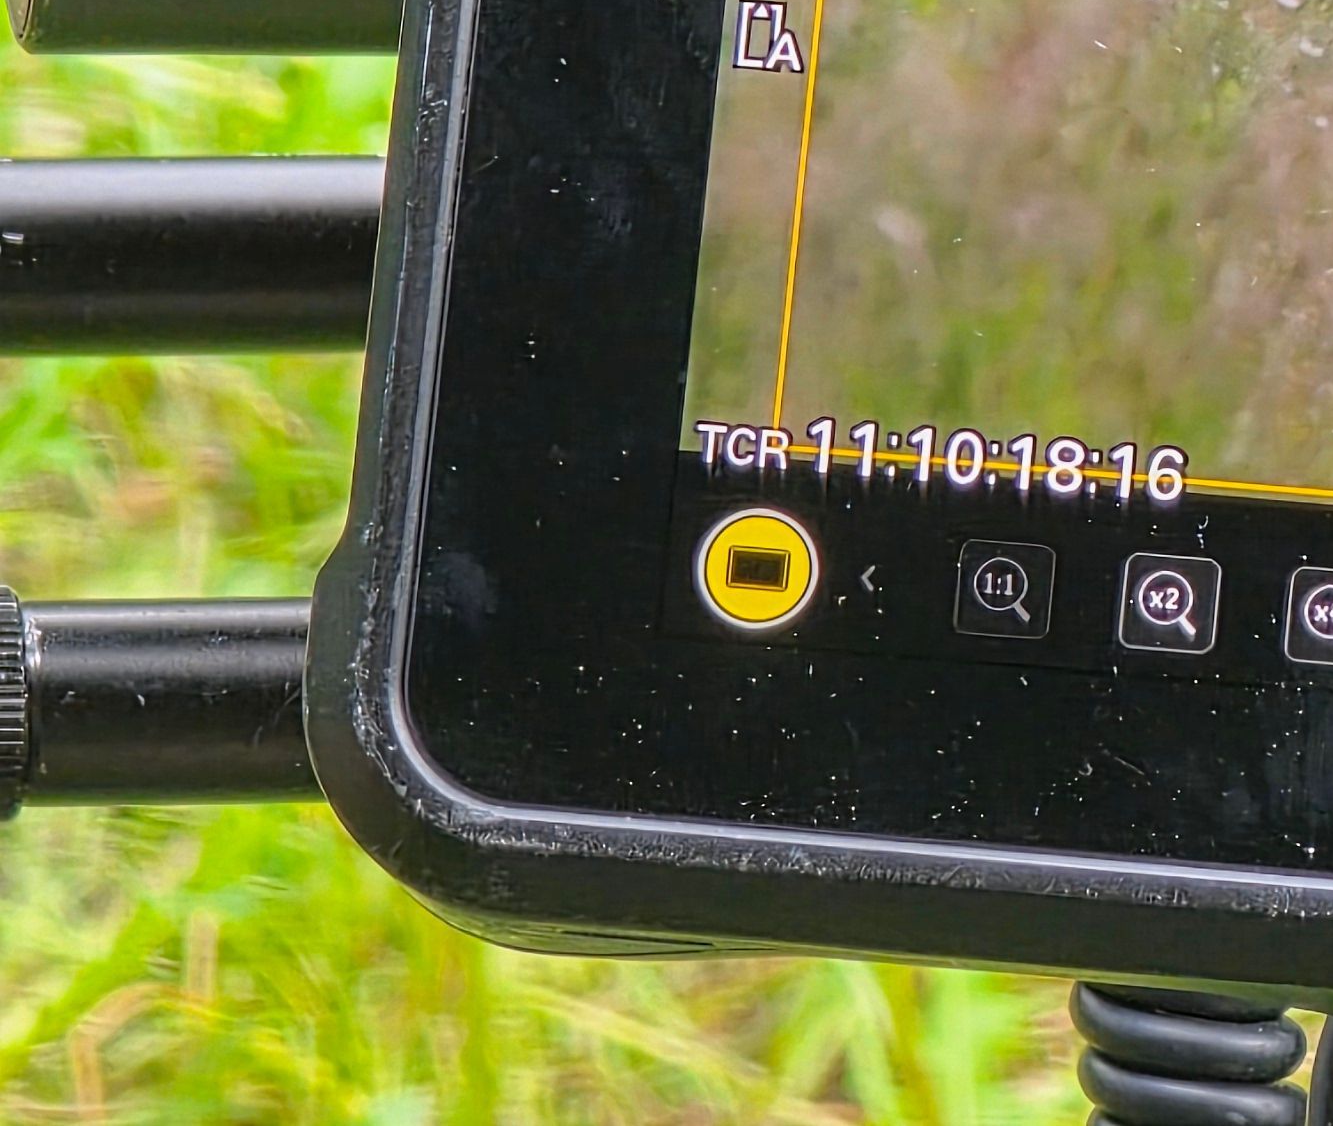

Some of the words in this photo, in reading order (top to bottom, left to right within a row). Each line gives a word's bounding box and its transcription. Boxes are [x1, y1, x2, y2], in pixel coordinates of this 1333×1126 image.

[696, 422, 790, 470] TCR
[806, 416, 1186, 502] 11:10:18:16
[983, 572, 1015, 597] 1:1
